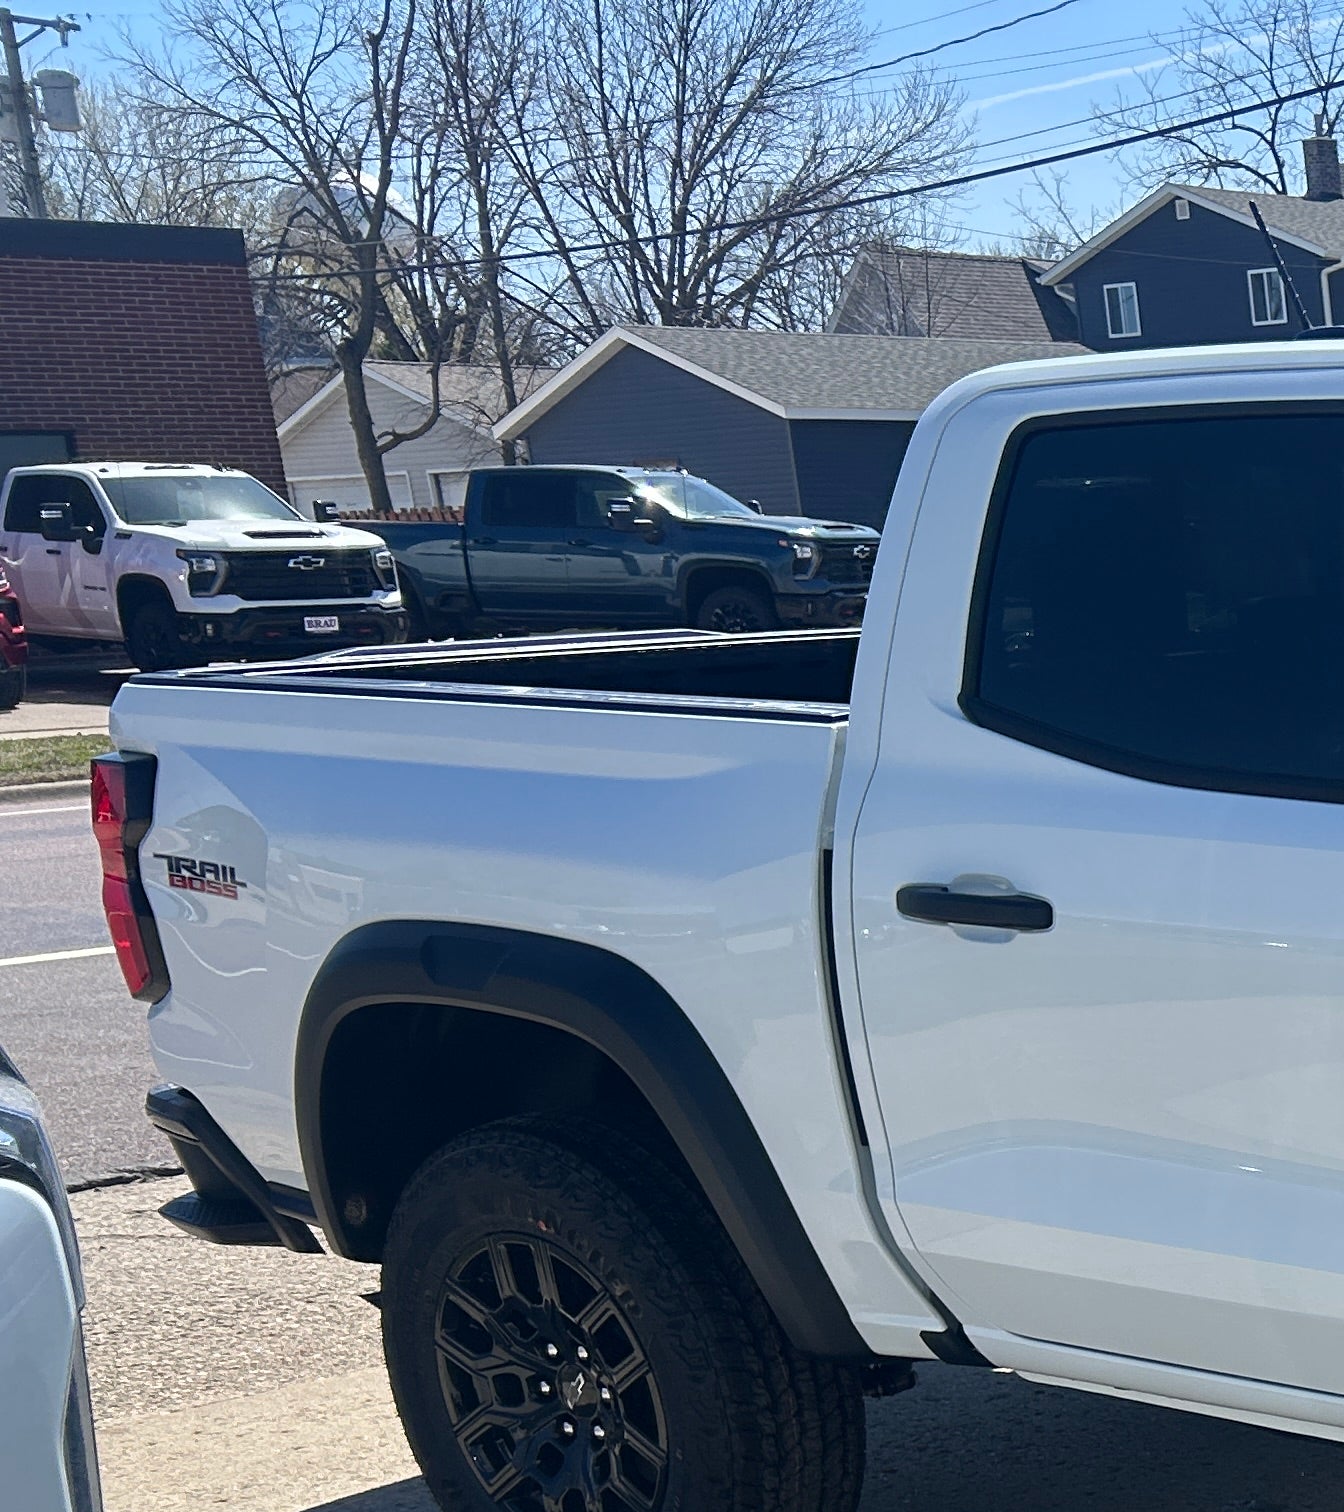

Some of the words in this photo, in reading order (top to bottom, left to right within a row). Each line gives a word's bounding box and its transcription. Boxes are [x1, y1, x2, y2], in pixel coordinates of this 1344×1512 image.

[306, 618, 336, 629] BRAU
[153, 852, 248, 889] TRAIL
[168, 873, 239, 901] BOSS
